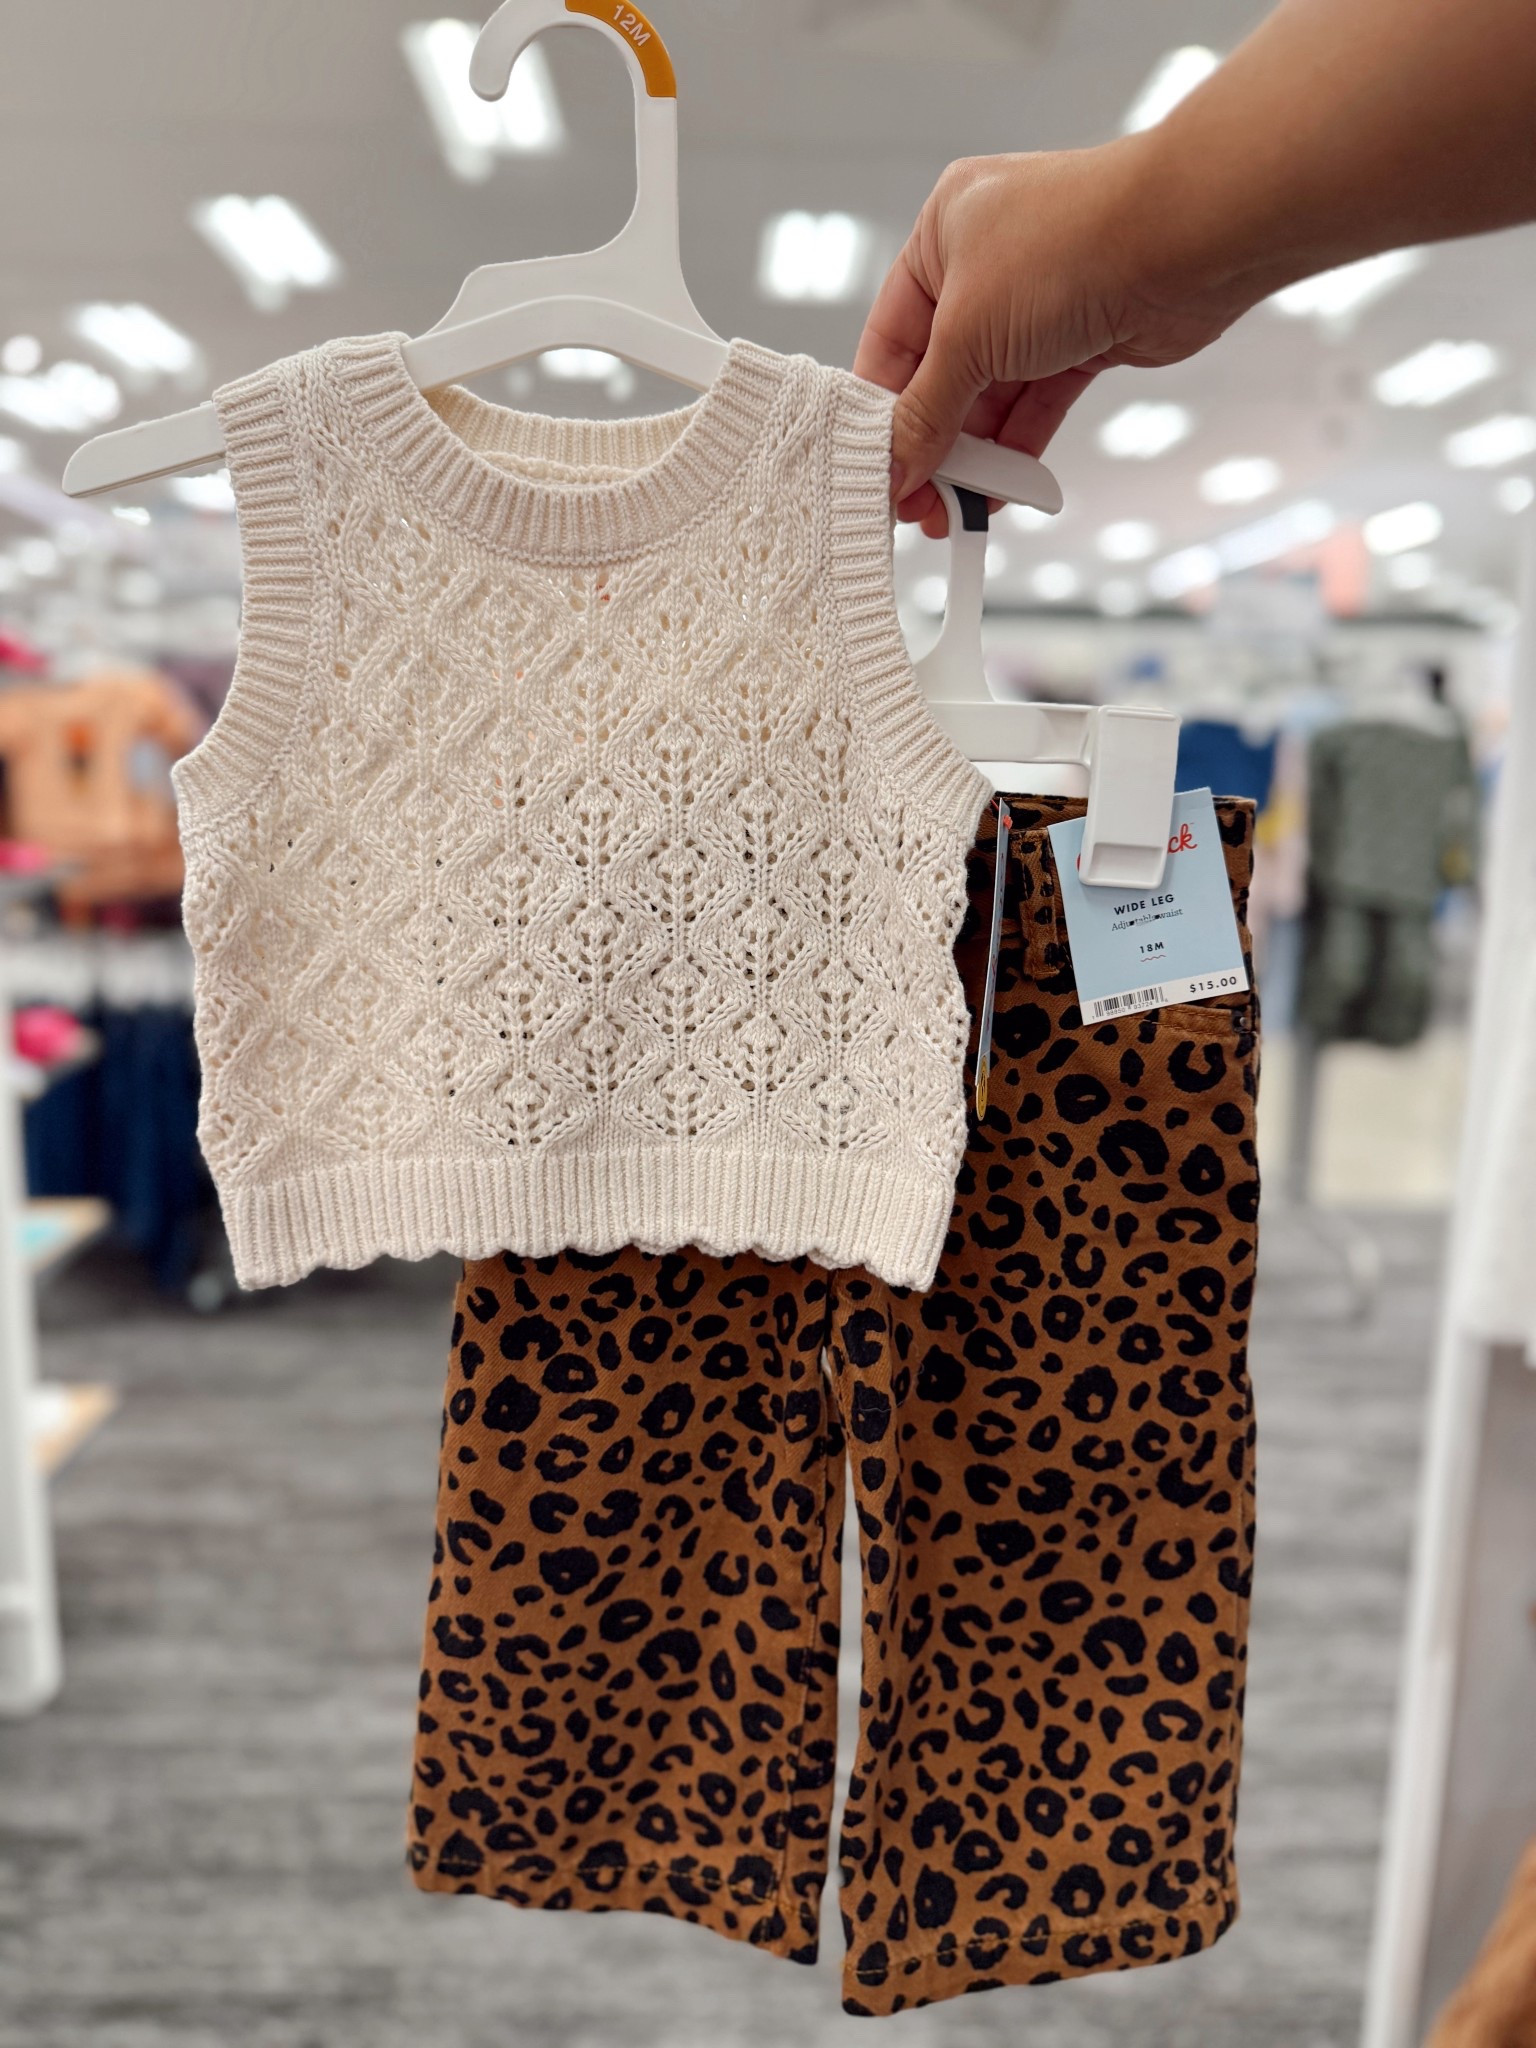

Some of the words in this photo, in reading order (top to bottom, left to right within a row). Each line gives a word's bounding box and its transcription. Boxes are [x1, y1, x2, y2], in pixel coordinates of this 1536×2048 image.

[613, 4, 652, 47] 12M
[1113, 900, 1147, 916] WIDE
[1150, 893, 1175, 907] LEG
[1158, 908, 1184, 919] waist
[1139, 941, 1165, 954] 18M
[1189, 976, 1237, 994] $15.00
